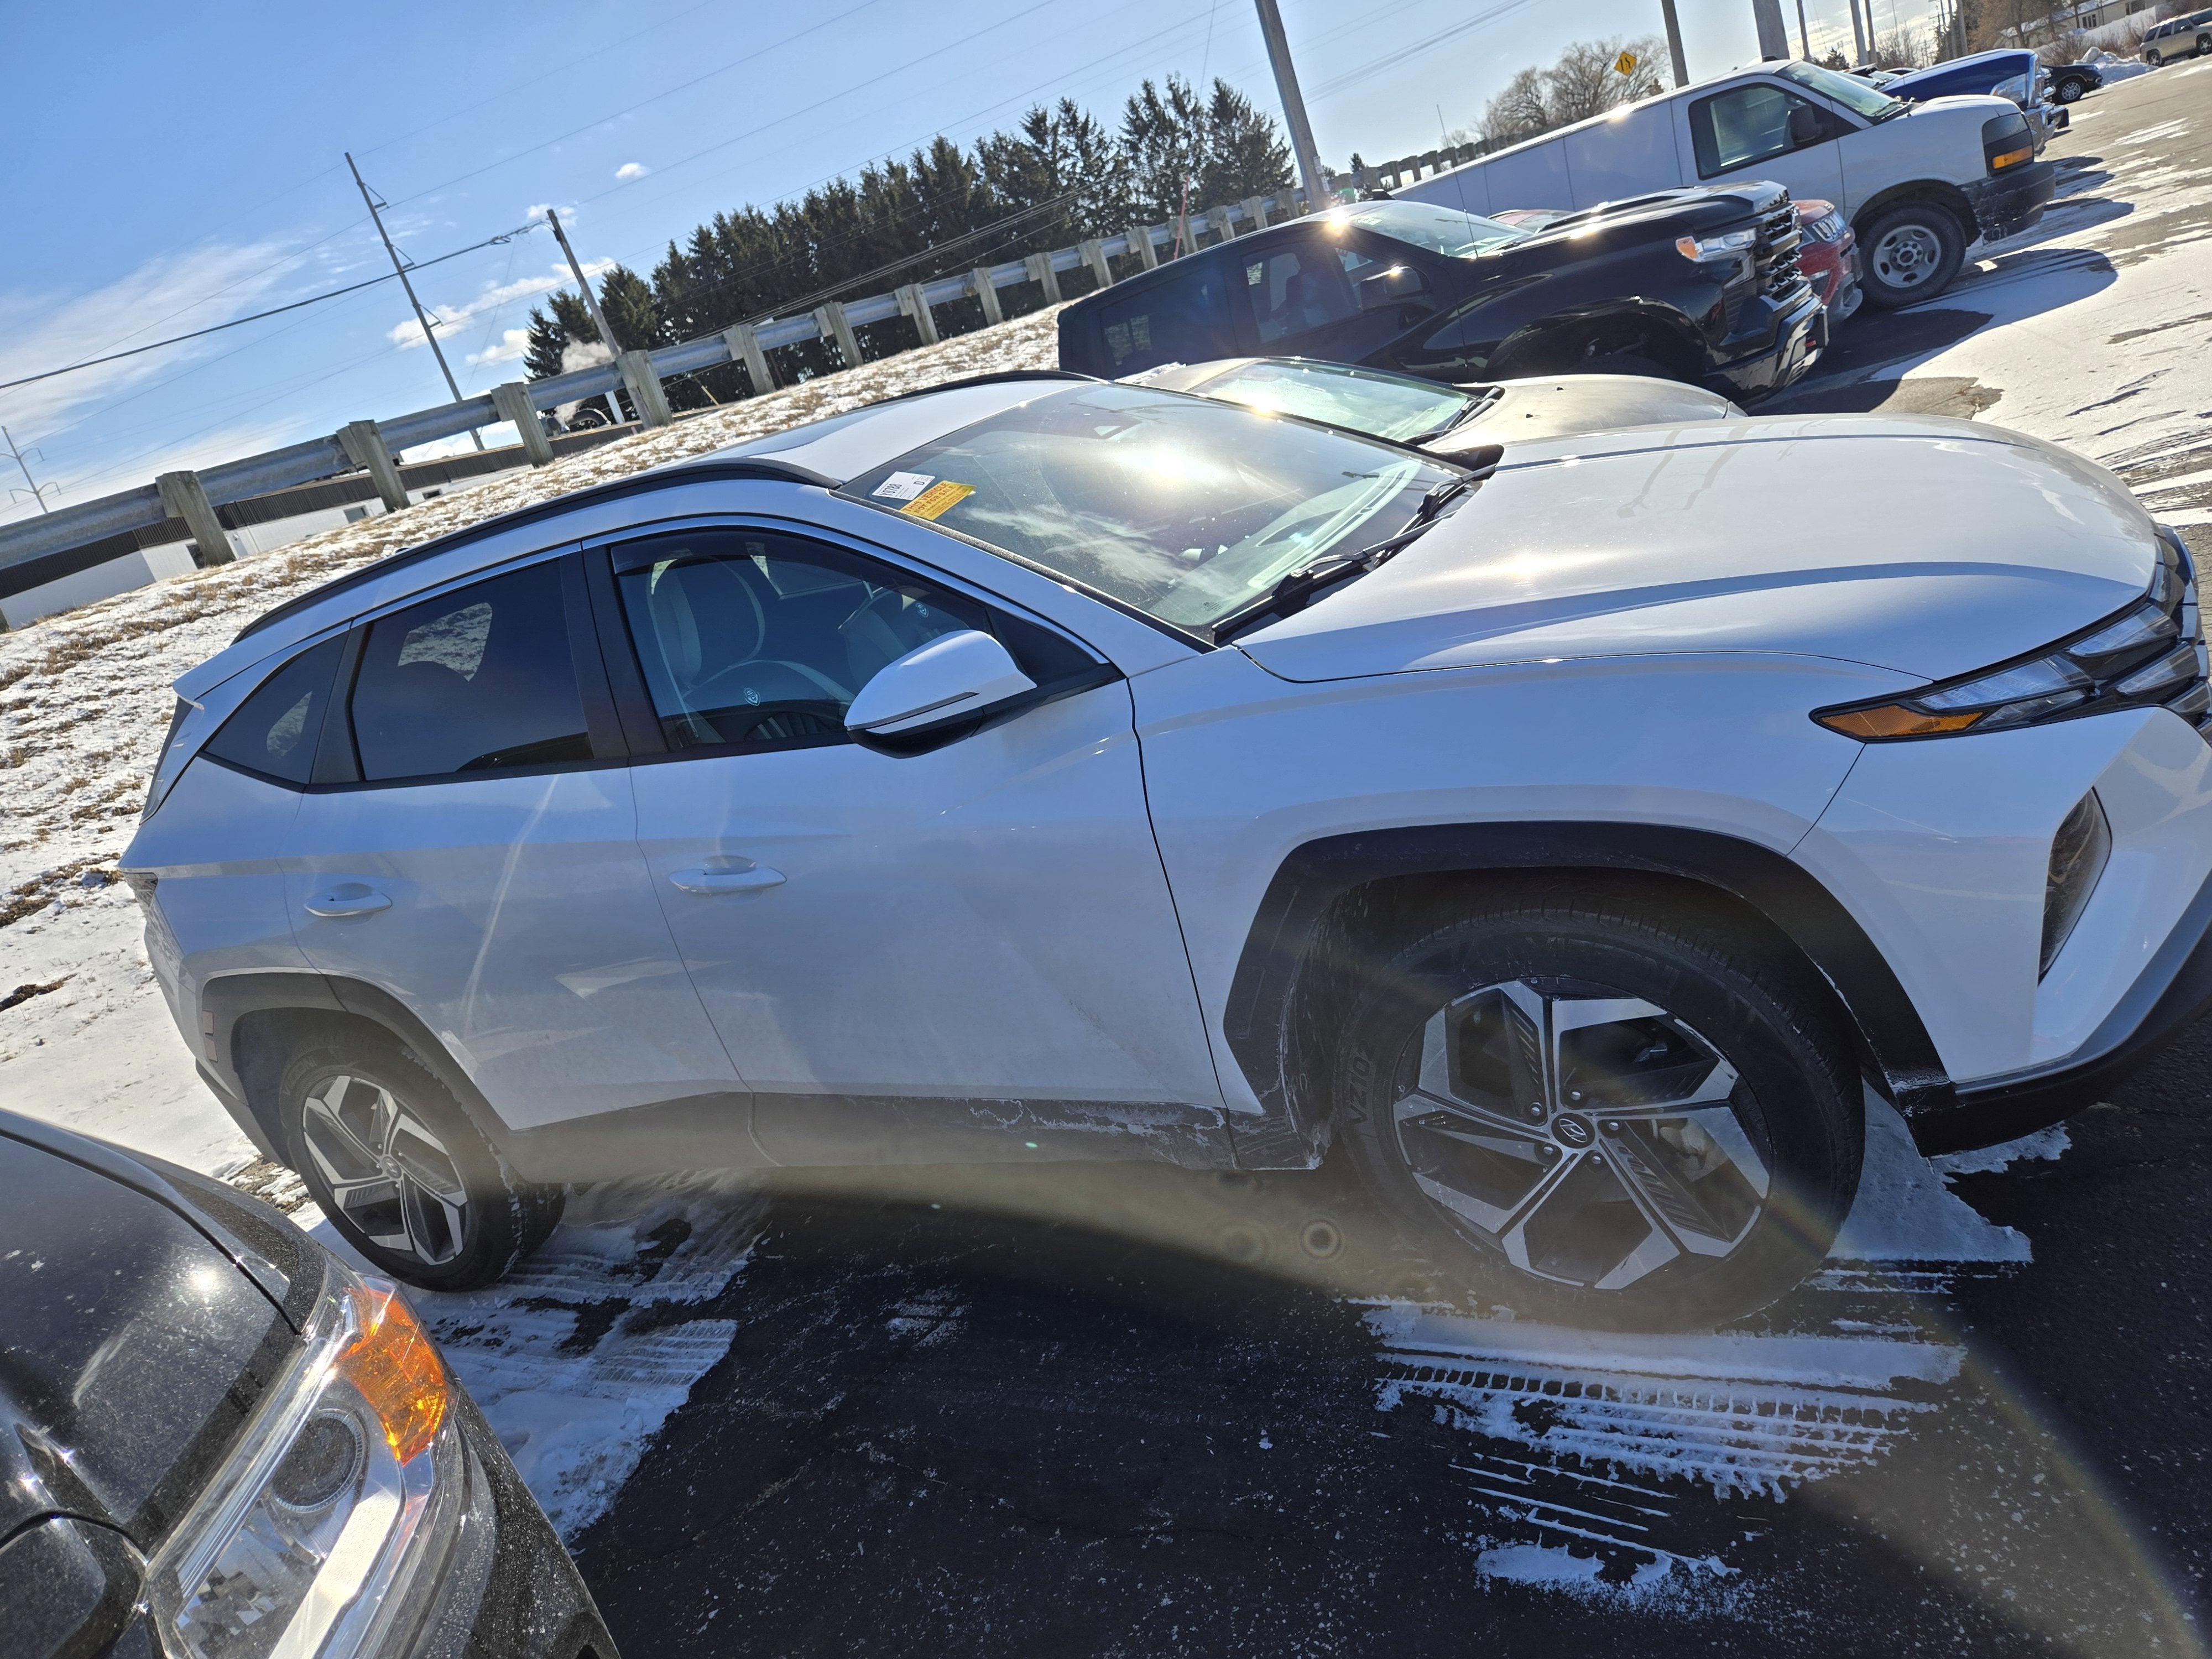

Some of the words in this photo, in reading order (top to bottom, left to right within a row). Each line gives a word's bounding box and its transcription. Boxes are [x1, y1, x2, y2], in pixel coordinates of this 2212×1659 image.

[904, 501, 922, 512] THIS
[920, 482, 948, 500] VEHICLE
[914, 504, 928, 514] NOT
[926, 495, 939, 504] FOR
[939, 486, 956, 495] SALE
